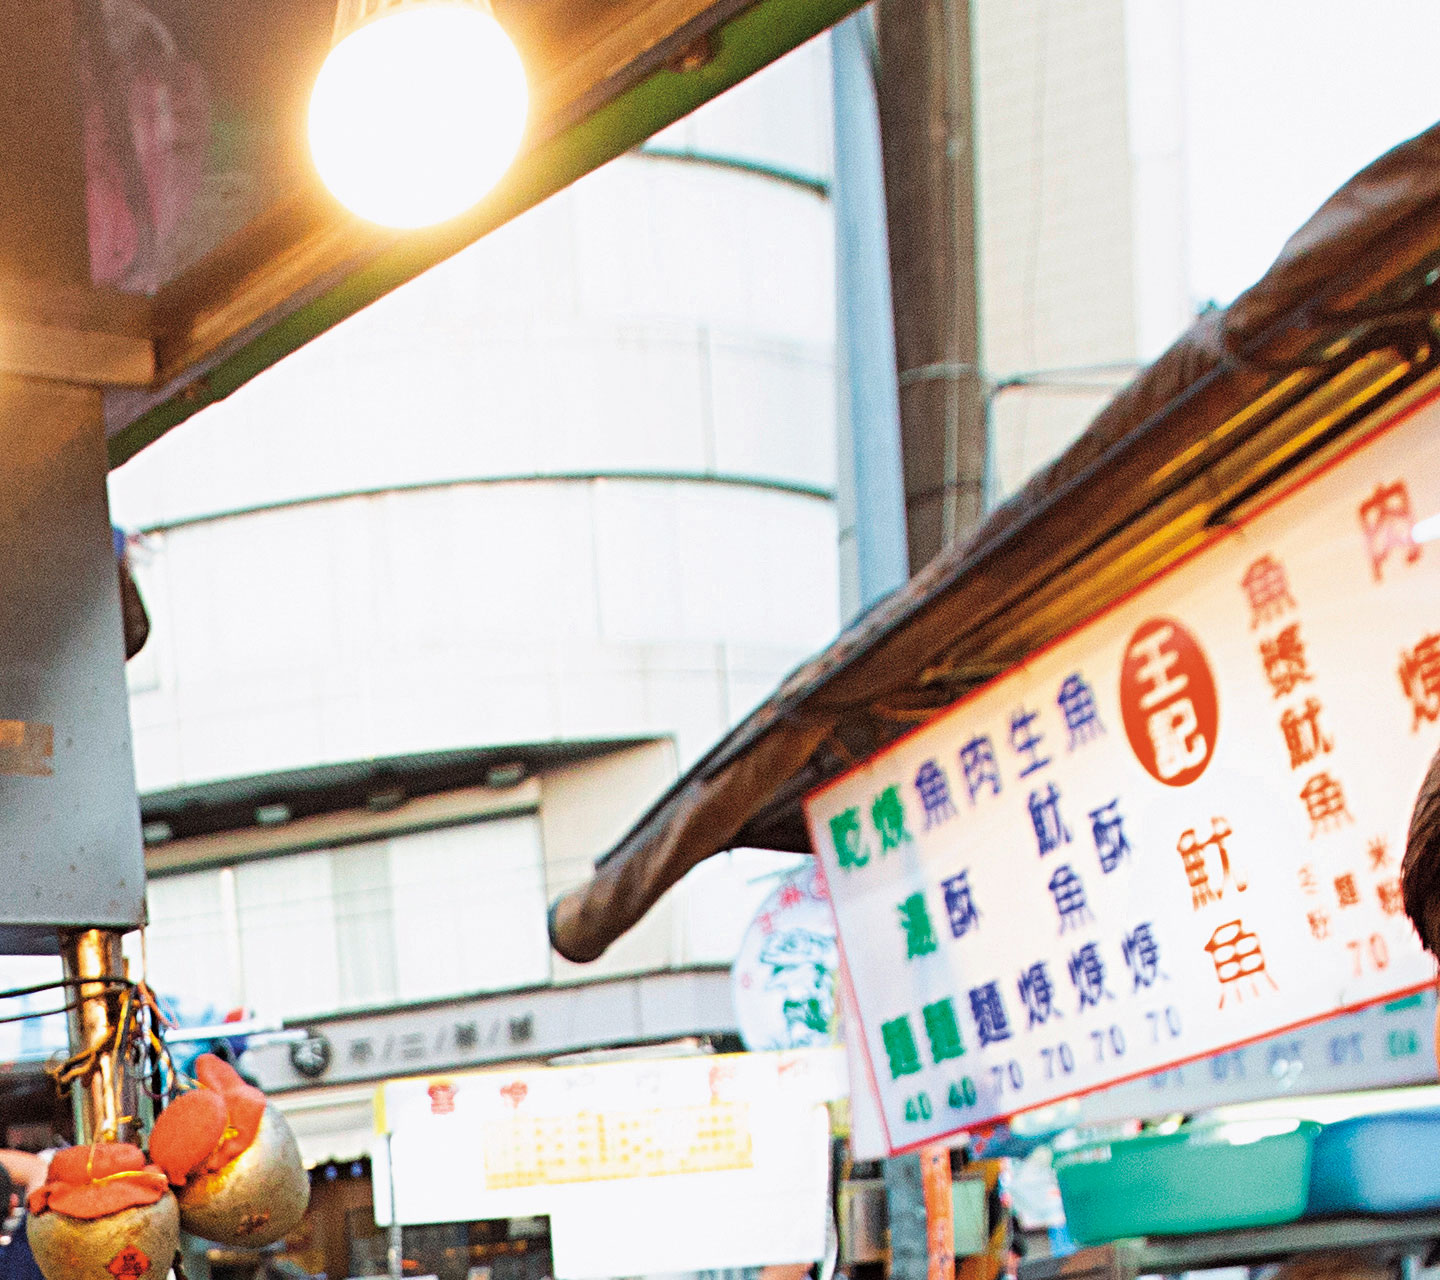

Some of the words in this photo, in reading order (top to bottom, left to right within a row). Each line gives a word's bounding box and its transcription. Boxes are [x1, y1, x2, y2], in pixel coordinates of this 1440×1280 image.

[1129, 624, 1209, 780] 王記
[1346, 933, 1390, 977] 70
[1146, 1006, 1181, 1044] 70
[1040, 1042, 1076, 1078] 70
[1091, 1025, 1125, 1062] 70
[947, 1075, 977, 1109] 40
[991, 1060, 1024, 1095] 70
[904, 1091, 933, 1123] 40
